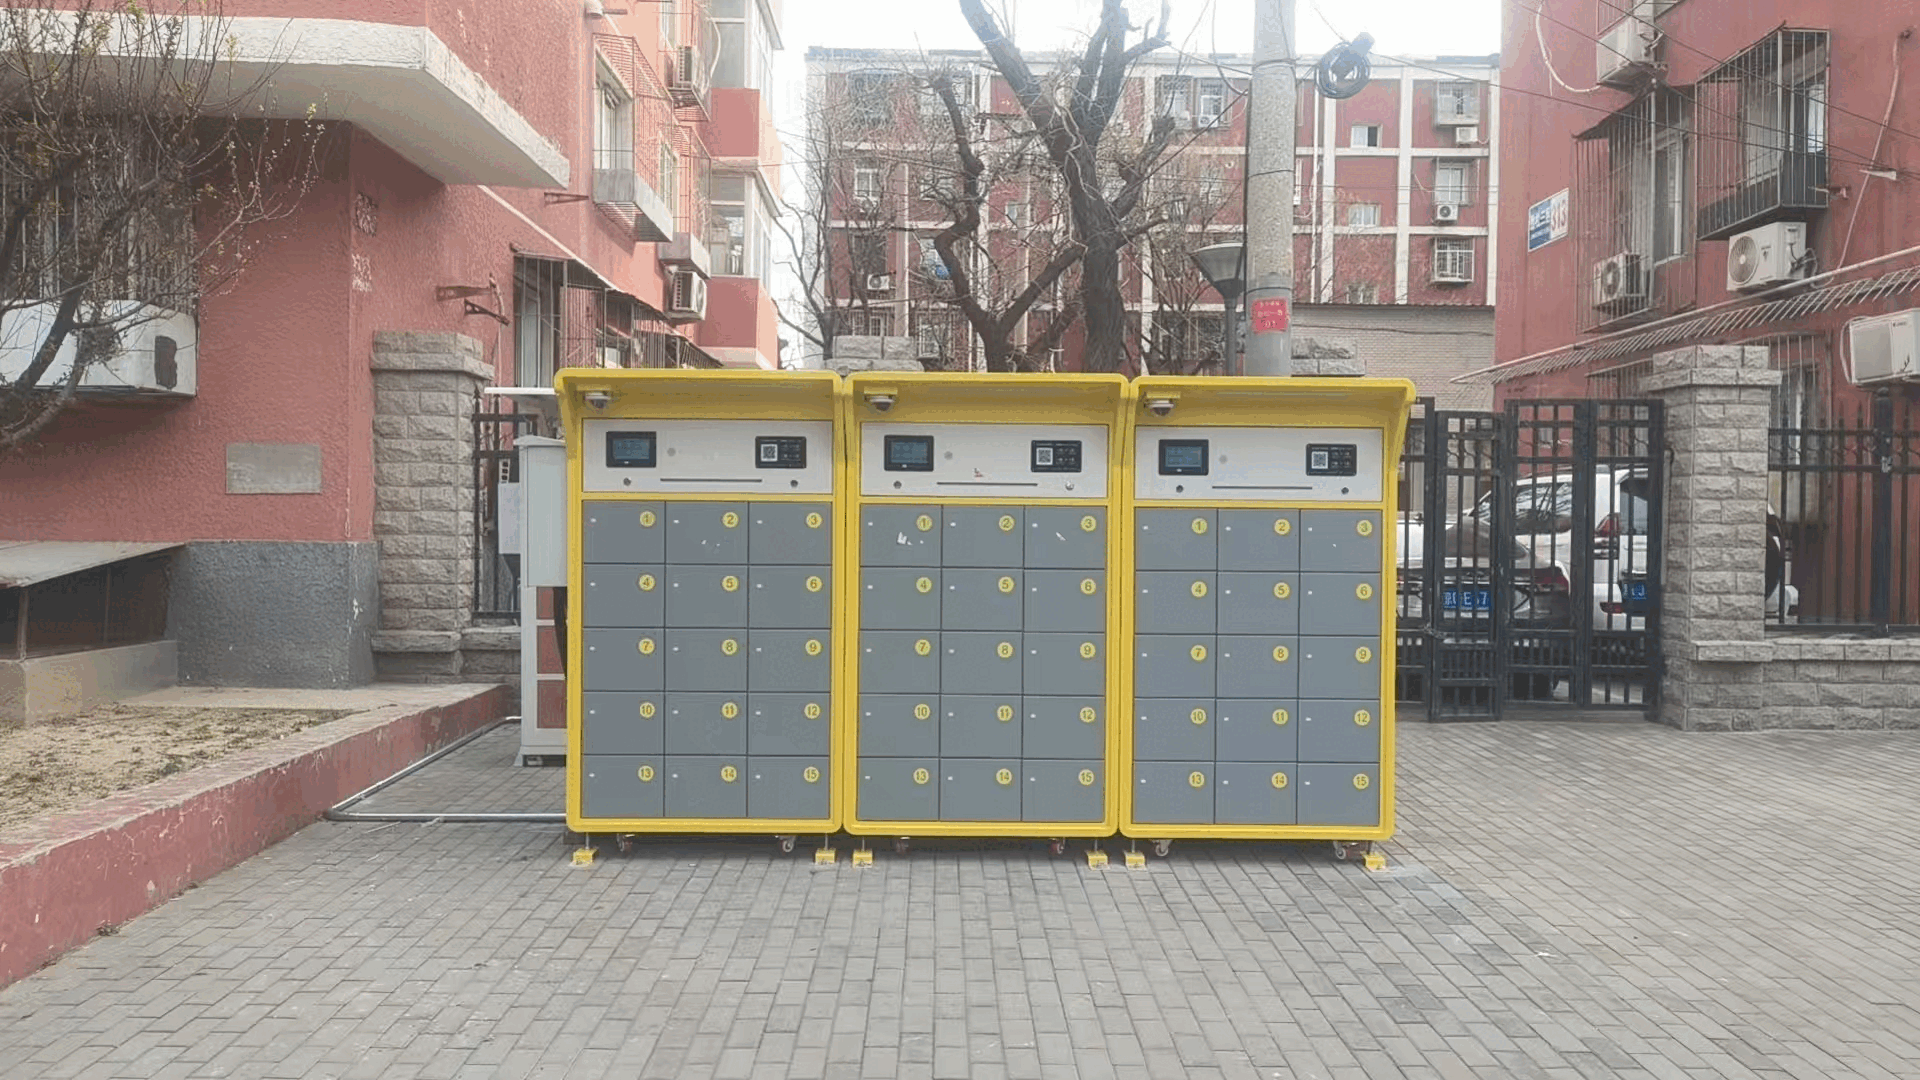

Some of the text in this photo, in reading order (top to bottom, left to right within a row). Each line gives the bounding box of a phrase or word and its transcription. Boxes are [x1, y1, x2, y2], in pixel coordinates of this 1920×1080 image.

[642, 705, 653, 715] 10
[725, 705, 734, 716] 11
[806, 706, 818, 716] 12
[916, 706, 928, 717] 10
[1000, 708, 1009, 719] 11
[1082, 710, 1093, 720] 12
[1192, 711, 1204, 722] 10
[1275, 712, 1285, 722] 11
[640, 768, 652, 778] 13
[806, 769, 817, 779] 15
[1081, 772, 1092, 783] 15
[1191, 774, 1202, 785] 13
